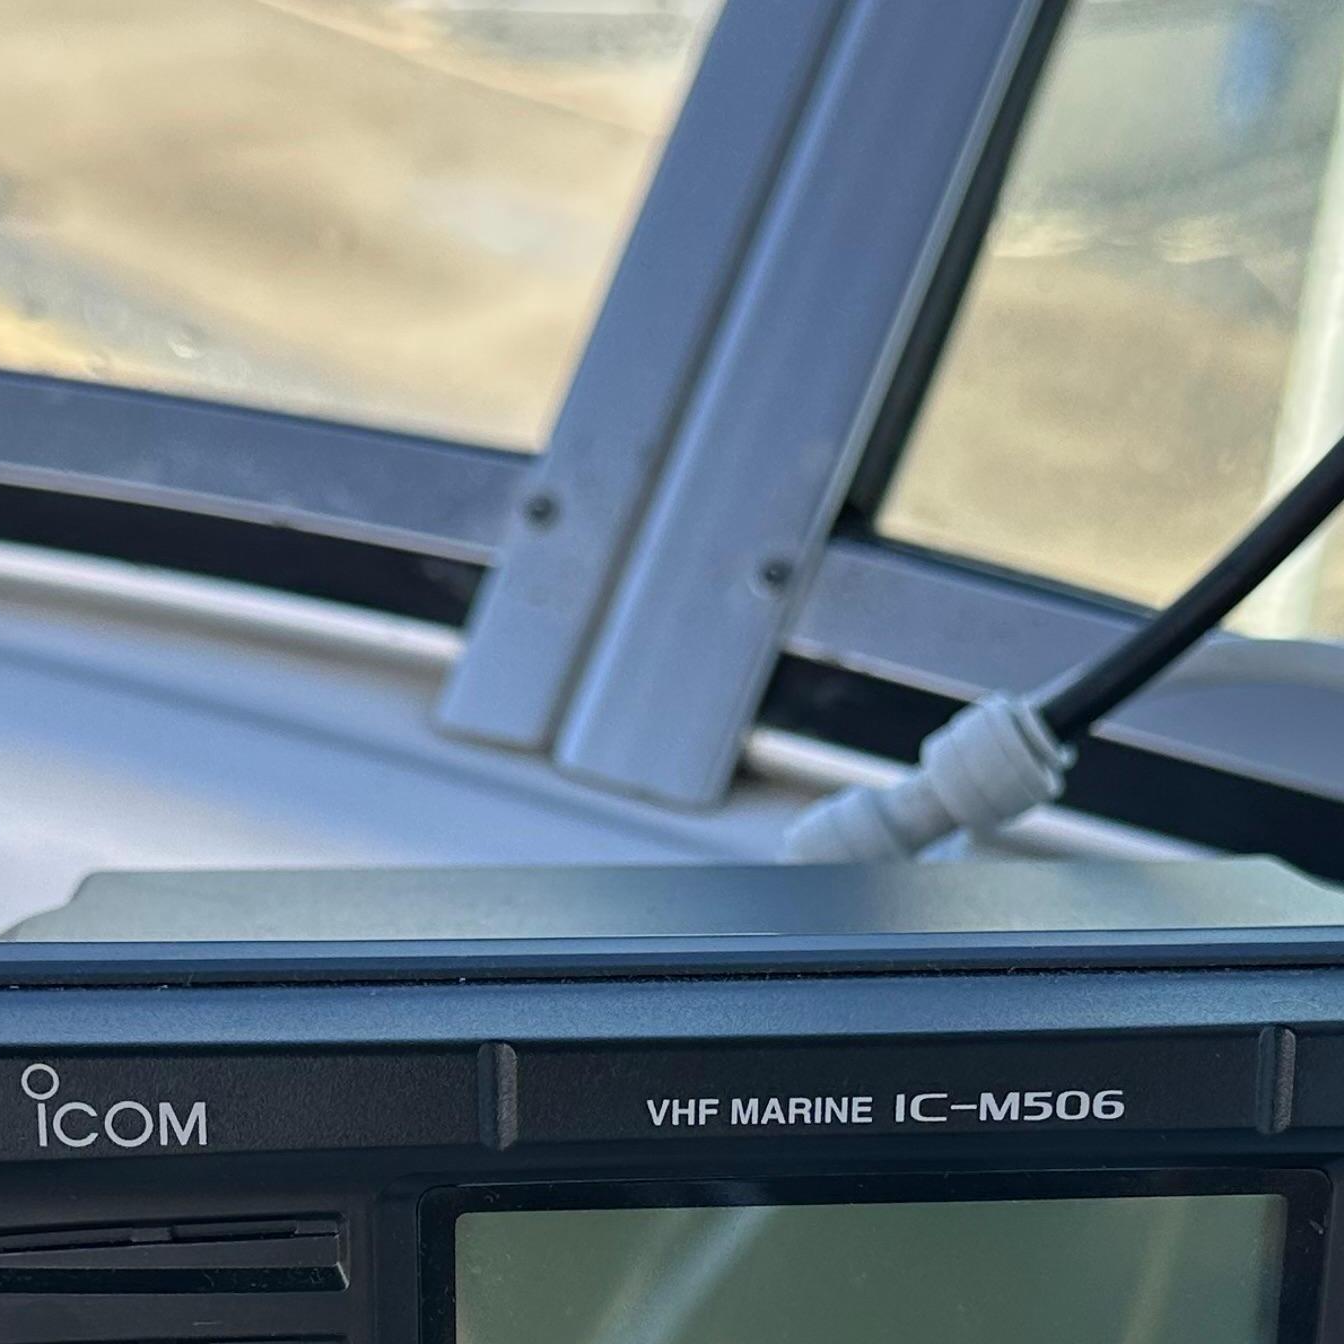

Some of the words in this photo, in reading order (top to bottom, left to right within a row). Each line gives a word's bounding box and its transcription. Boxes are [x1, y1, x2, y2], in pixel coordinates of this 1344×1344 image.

[647, 1098, 719, 1127] VHF
[730, 1096, 872, 1125] MARINE
[895, 1089, 1125, 1123] IC-M506
